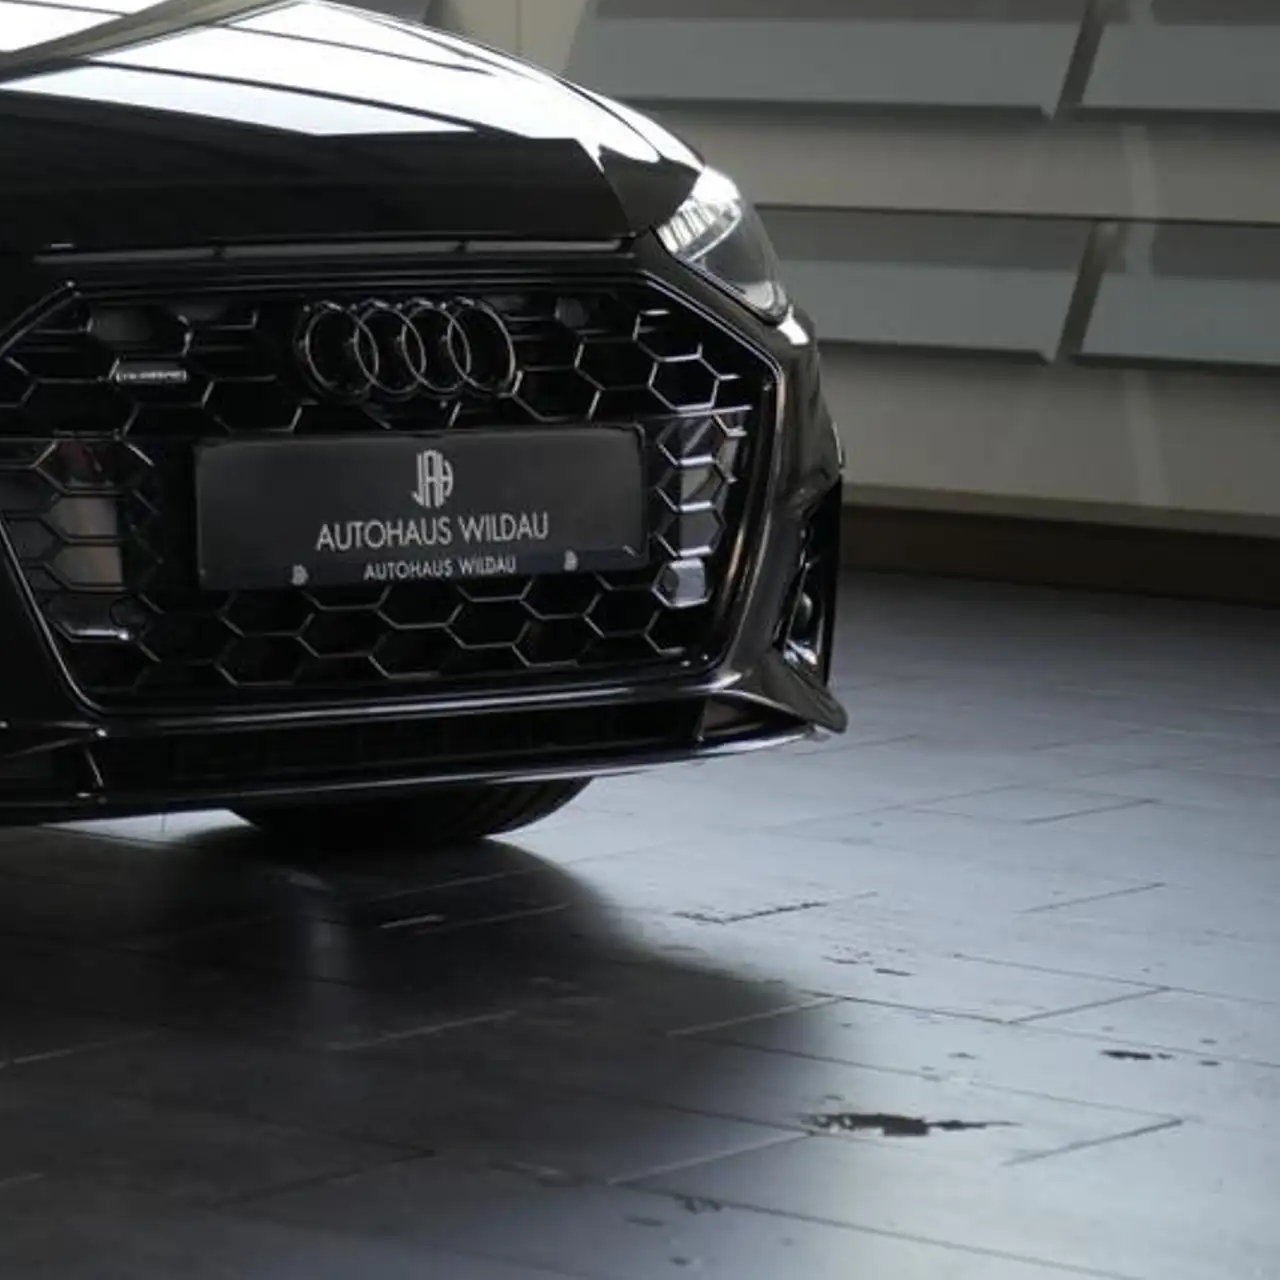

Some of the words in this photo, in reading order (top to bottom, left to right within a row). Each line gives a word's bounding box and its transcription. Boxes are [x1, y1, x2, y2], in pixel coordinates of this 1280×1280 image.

[316, 516, 453, 552] AUTOHAUS
[457, 511, 549, 544] WILDAU
[363, 558, 453, 581] AUTOHAUS
[458, 554, 516, 575] WILDAU
